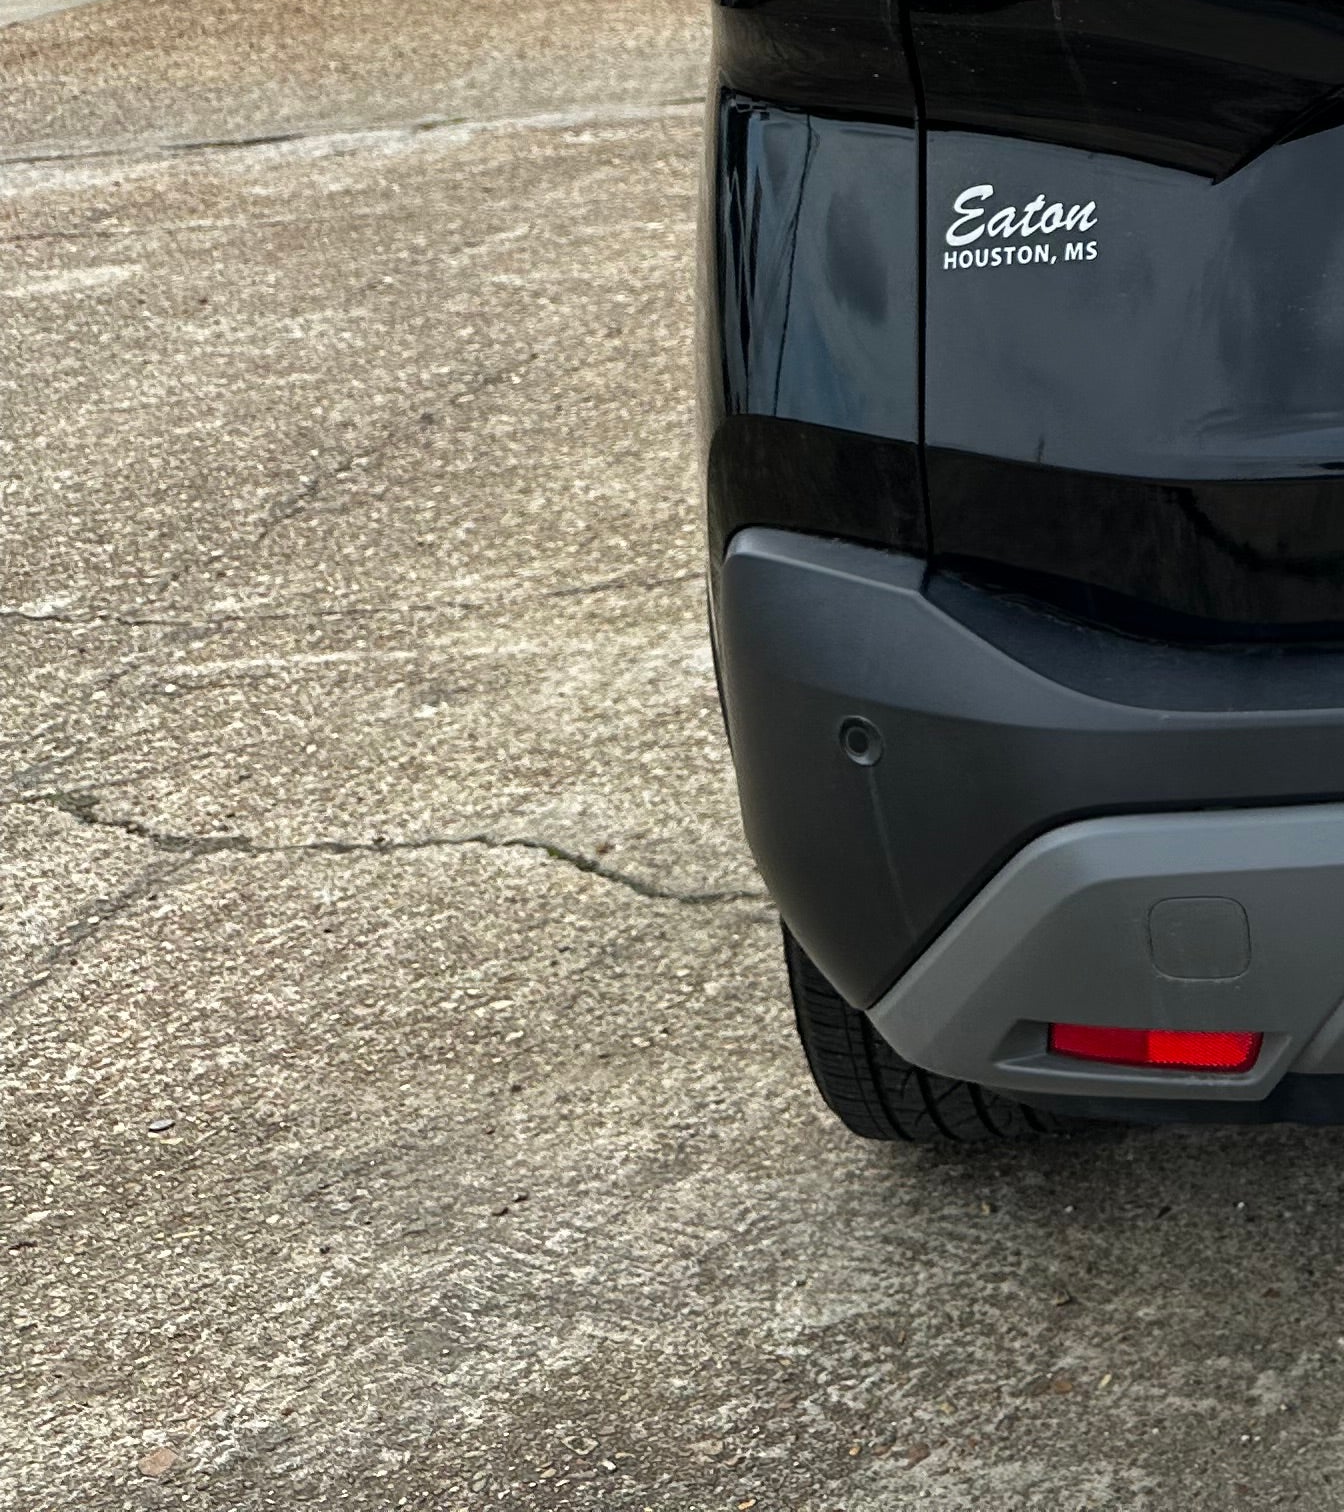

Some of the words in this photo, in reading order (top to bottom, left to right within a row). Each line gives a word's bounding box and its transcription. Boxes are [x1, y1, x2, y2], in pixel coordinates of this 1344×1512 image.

[946, 184, 1098, 246] Eaton
[943, 243, 1057, 270] HOUSTON,
[1064, 240, 1098, 261] MS
